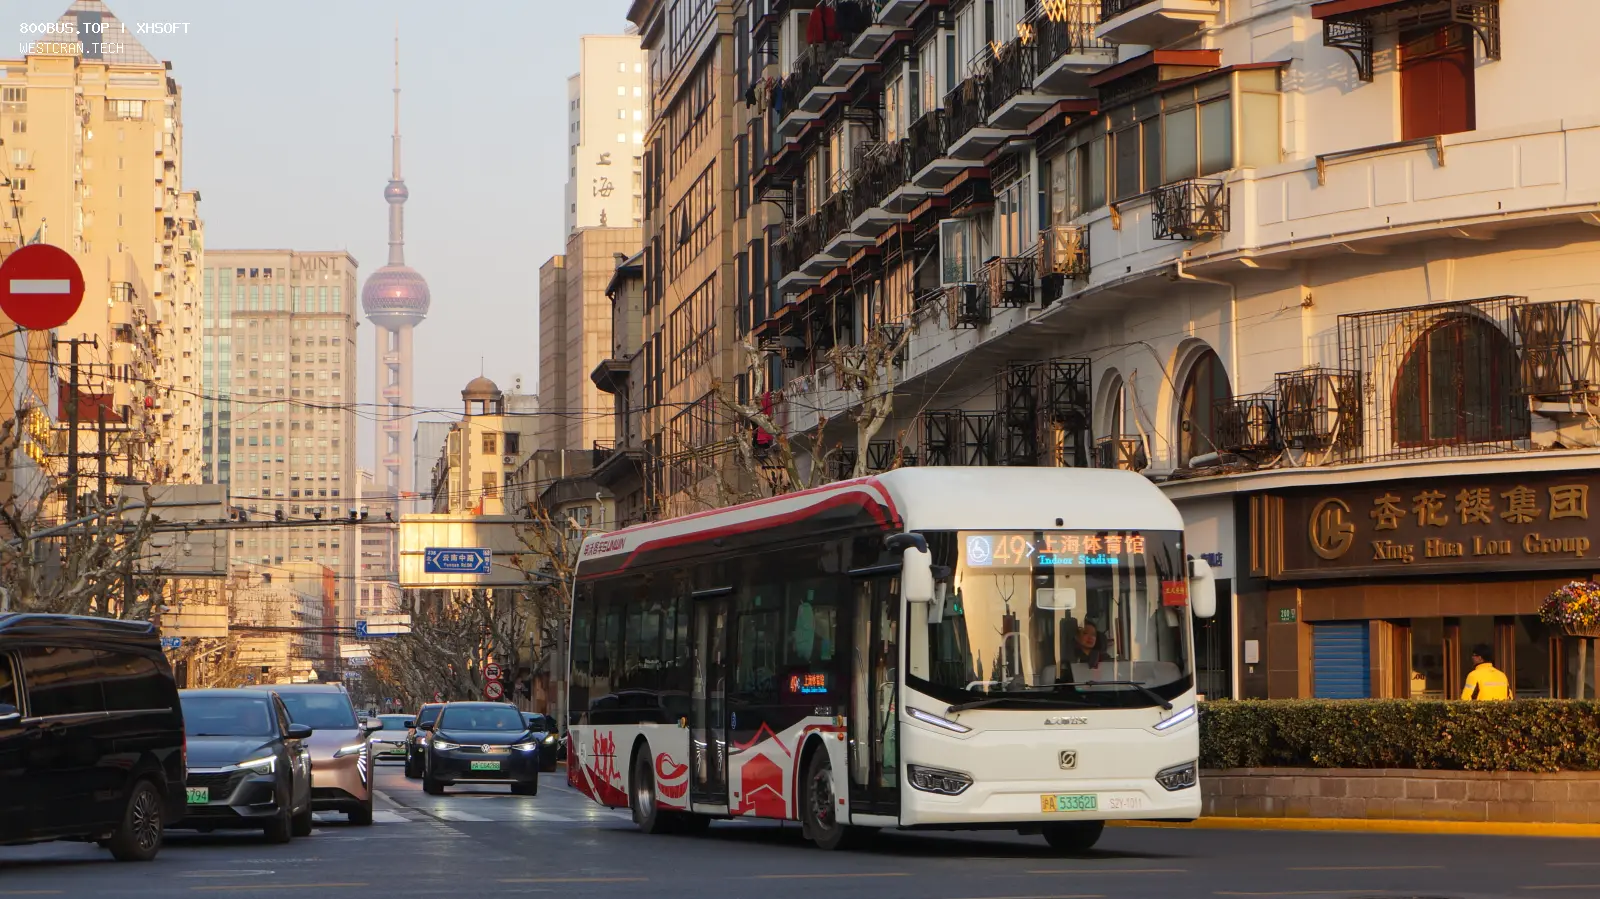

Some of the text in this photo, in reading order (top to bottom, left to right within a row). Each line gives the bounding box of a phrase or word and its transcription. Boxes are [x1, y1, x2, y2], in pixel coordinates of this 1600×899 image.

[300, 256, 339, 270] MINT
[1370, 484, 1589, 531] 杏花楼集团
[443, 554, 474, 562] 云南中路
[993, 535, 1146, 565] 49 上海体育馆
[1371, 532, 1590, 563] Xing Hua Lou Group
[1038, 554, 1119, 566] Indoor Stadium
